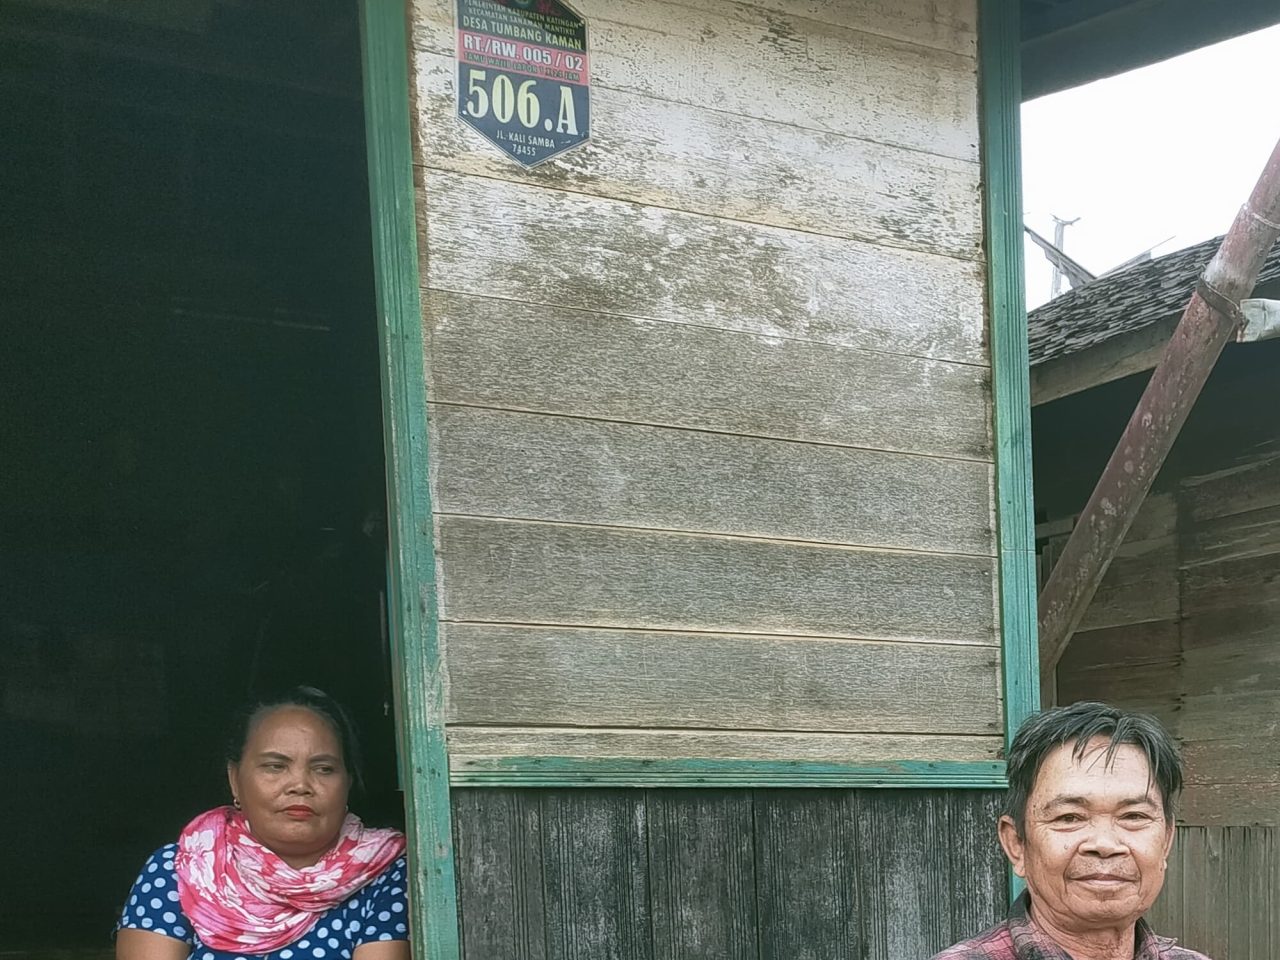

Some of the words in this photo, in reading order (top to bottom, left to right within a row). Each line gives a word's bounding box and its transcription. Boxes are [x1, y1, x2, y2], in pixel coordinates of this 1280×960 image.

[463, 15, 488, 31] DESA
[491, 21, 542, 42] TUMBANG
[545, 32, 581, 50] KAMAN
[523, 46, 551, 65] 005
[565, 55, 584, 71] 02
[466, 68, 578, 136] 506.A
[508, 131, 526, 144] KALI
[527, 135, 555, 149] SAMBA
